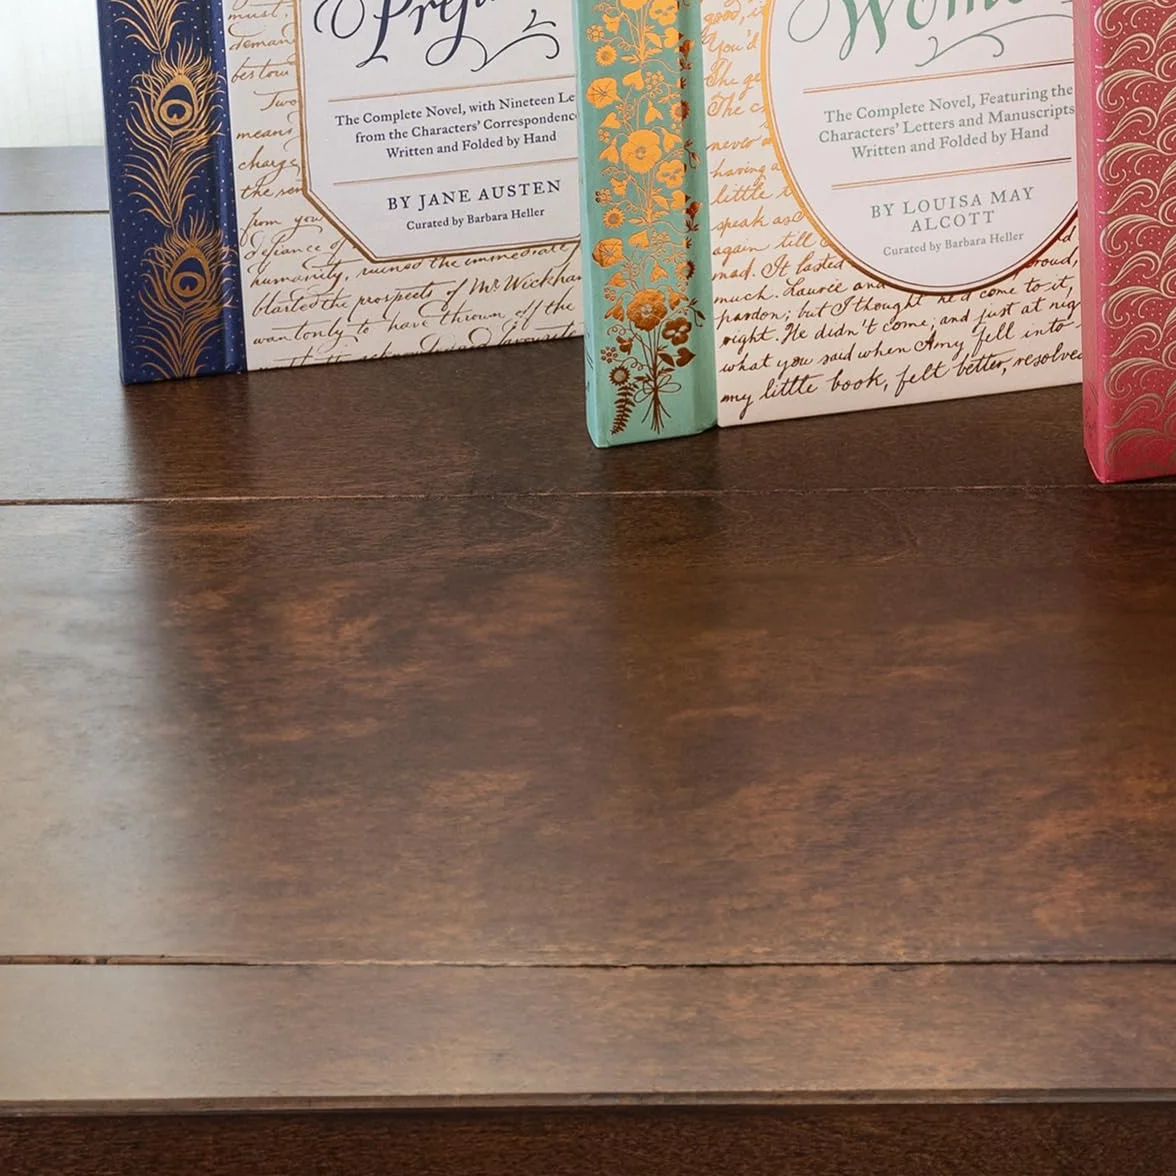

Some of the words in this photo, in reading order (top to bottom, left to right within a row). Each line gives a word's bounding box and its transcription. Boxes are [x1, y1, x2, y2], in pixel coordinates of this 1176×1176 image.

[335, 114, 360, 126] The
[362, 109, 422, 126] Complete
[425, 104, 466, 118] Novel,
[469, 100, 496, 114] with
[499, 95, 555, 110] Nineteen
[824, 109, 852, 124] The
[856, 103, 926, 122] Complete
[928, 96, 976, 112] Novel,
[979, 87, 1049, 106] Featuring
[1051, 84, 1074, 98] the
[903, 118, 956, 135] Letters
[958, 114, 984, 128] and
[988, 103, 1076, 124] Manuscripts
[355, 131, 386, 144] from
[389, 128, 408, 140] the
[386, 145, 434, 159] Written
[437, 141, 458, 154] and
[462, 137, 504, 150] Folded
[506, 135, 520, 149] by
[524, 131, 558, 144] Hand
[851, 142, 906, 160] Written
[910, 139, 936, 154] and
[939, 133, 988, 150] Folded
[991, 130, 1008, 147] by
[1010, 124, 1050, 142] Hand
[387, 196, 411, 210] BY
[418, 189, 472, 212] JANE
[479, 180, 562, 201] AUSTEN
[870, 202, 896, 219] BY
[903, 193, 988, 216] LOUISA
[990, 186, 1035, 205] MAY
[406, 217, 450, 231] Curated
[452, 216, 464, 228] by
[467, 212, 508, 225] Barbara
[511, 208, 546, 220] Heller
[910, 210, 996, 234] ALCOTT
[882, 242, 927, 257] Curated
[929, 240, 942, 254] by
[945, 235, 986, 250] Barbara
[989, 231, 1025, 245] Heller
[714, 285, 780, 305] much.
[783, 277, 849, 298] Laurie
[719, 353, 771, 374] what
[776, 356, 814, 380] you
[819, 343, 856, 366] said
[857, 339, 912, 358] when
[913, 329, 965, 362] Amy
[972, 321, 1016, 358] fell
[1022, 317, 1076, 338] into
[780, 322, 809, 346] He
[720, 394, 754, 420] my
[759, 377, 824, 401] little
[826, 367, 888, 392] book,
[895, 361, 950, 398] felt
[952, 348, 1016, 377] better,
